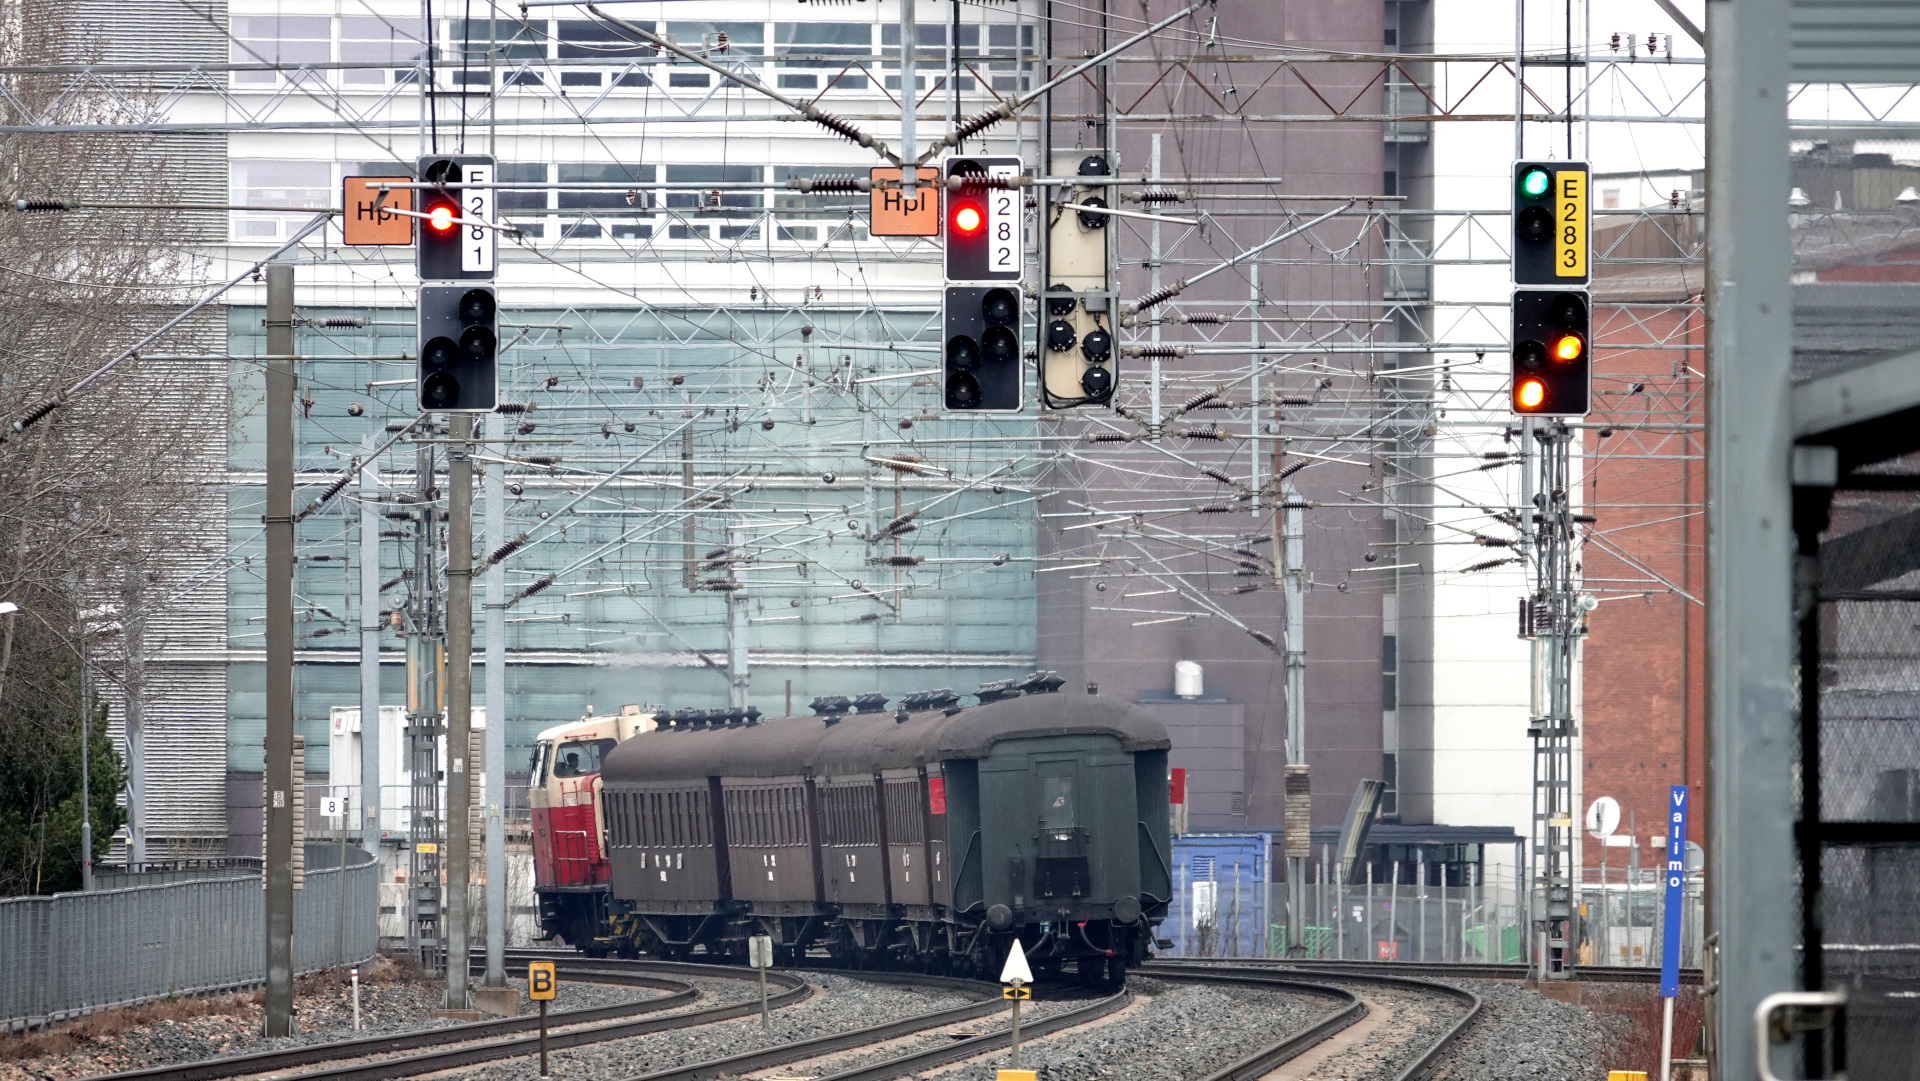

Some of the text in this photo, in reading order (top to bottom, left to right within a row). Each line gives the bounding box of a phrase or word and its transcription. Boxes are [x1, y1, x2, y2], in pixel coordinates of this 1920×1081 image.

[997, 172, 1011, 265] 282
[1563, 179, 1578, 268] E283
[328, 801, 336, 813] 8
[1668, 793, 1685, 888] Valimo
[533, 969, 552, 993] B
